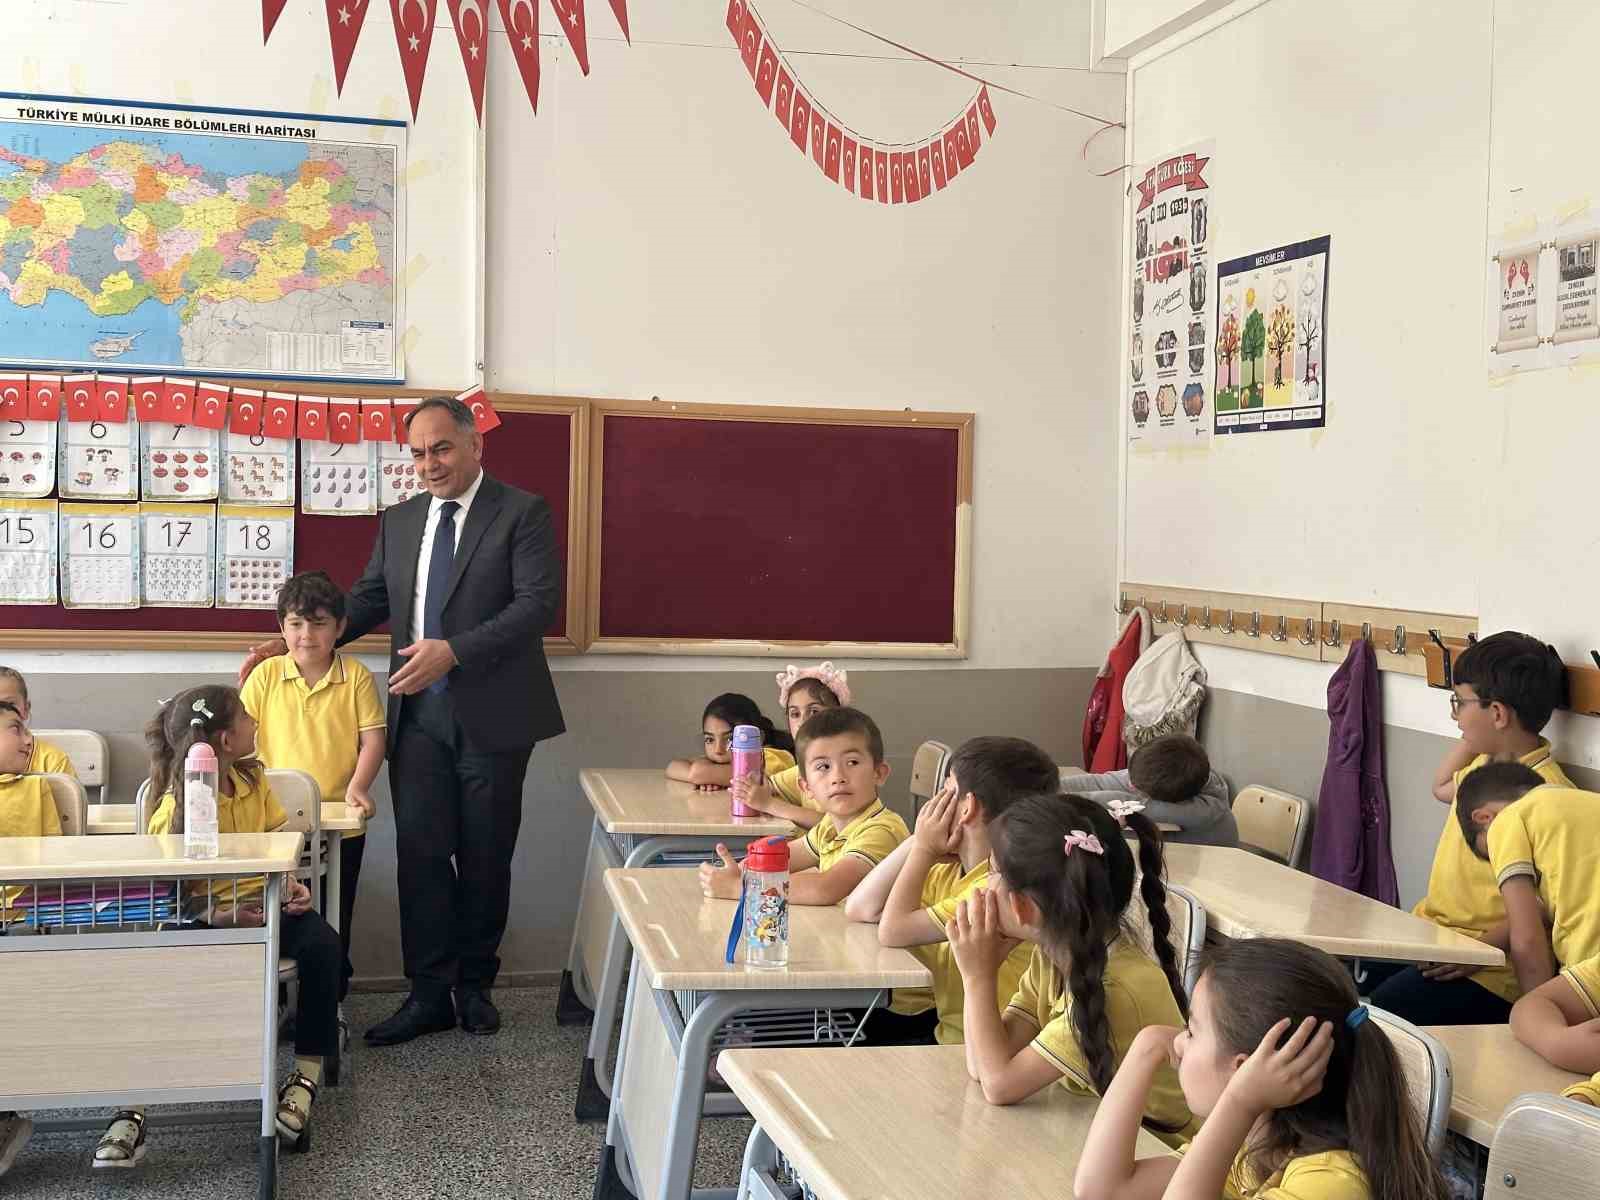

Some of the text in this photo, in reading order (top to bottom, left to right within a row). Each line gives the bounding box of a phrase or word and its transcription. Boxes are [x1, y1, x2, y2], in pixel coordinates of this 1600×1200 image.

[17, 107, 316, 138] TÜRKİYE MÜLKİ İDARE BÖLÜMLERİ HARİTASI
[0, 517, 34, 544] 15
[82, 522, 116, 549] 16
[161, 521, 192, 547] 17
[239, 525, 271, 550] 18
